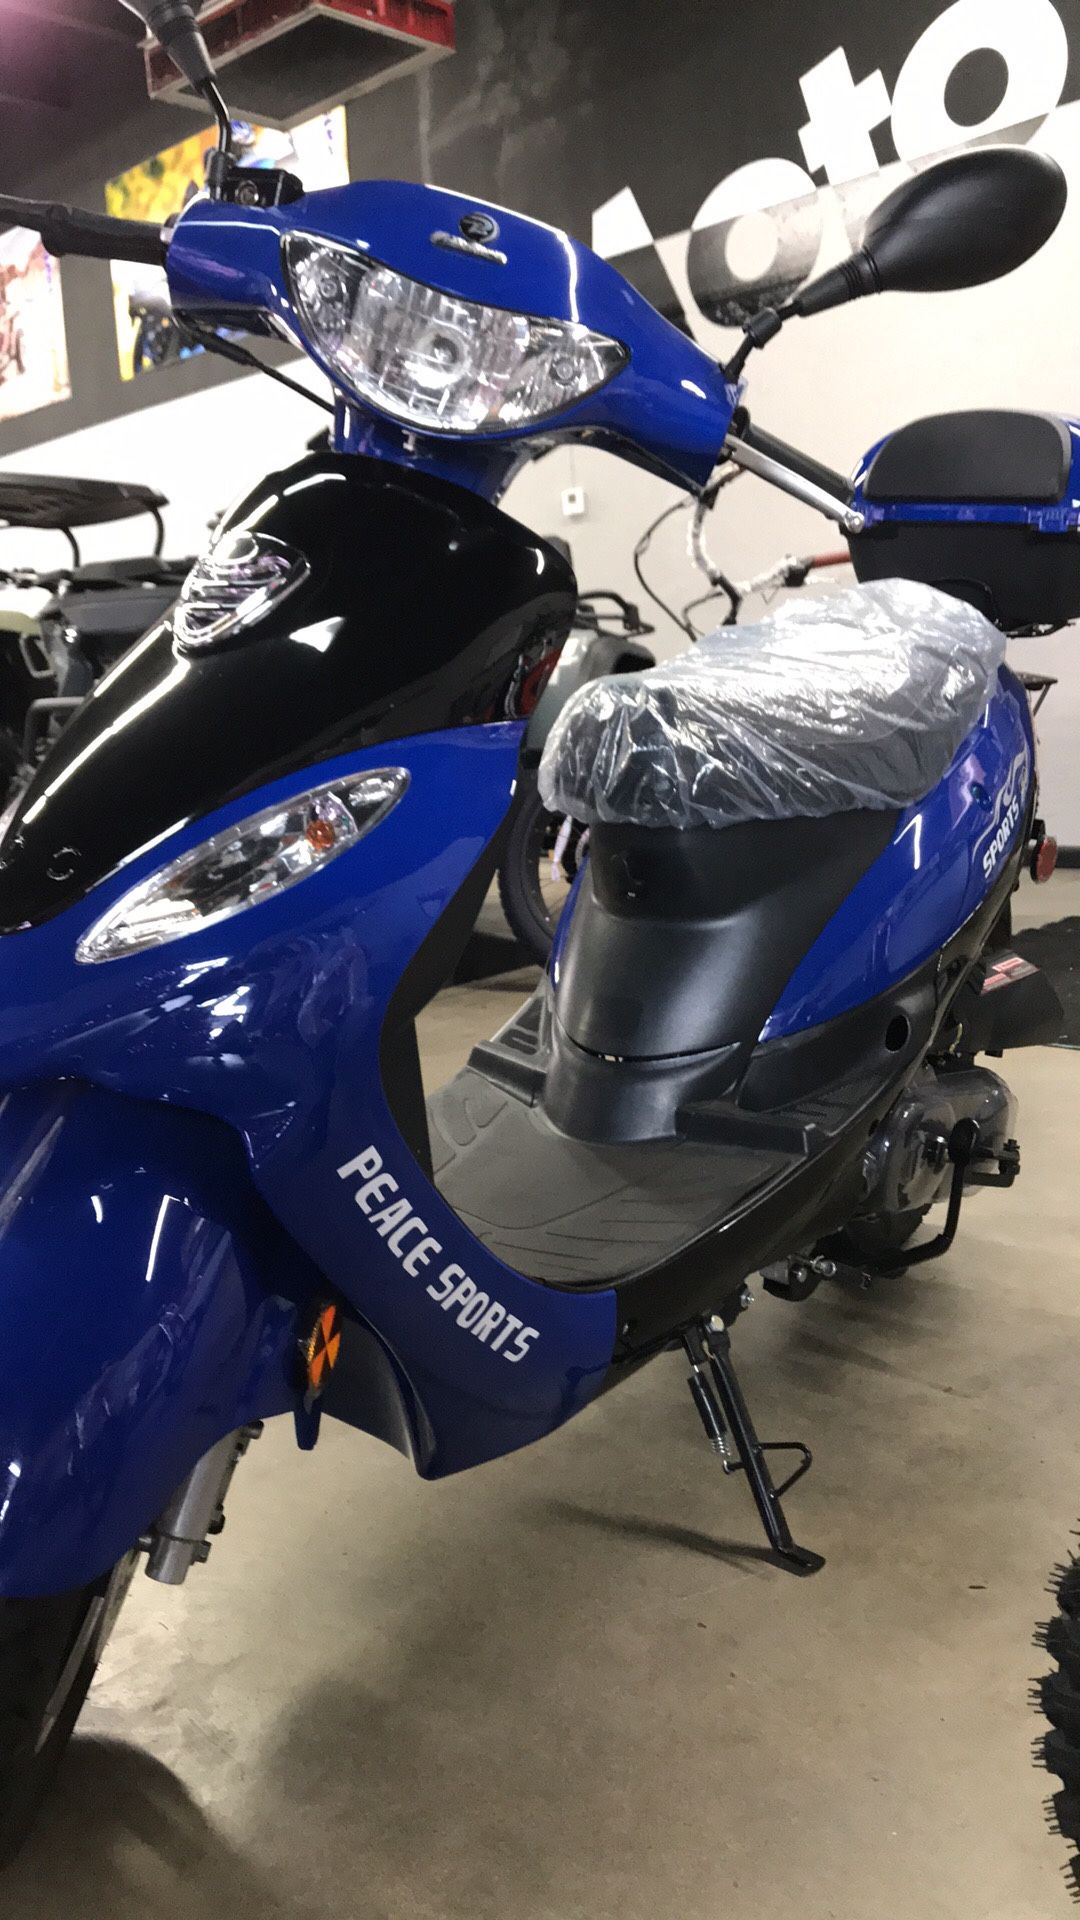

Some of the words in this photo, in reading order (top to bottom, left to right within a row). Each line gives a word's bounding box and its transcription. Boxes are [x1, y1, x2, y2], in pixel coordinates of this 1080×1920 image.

[983, 795, 1019, 879] SPORTS
[336, 1145, 443, 1278] PEACE
[426, 1263, 540, 1363] SPORTS
